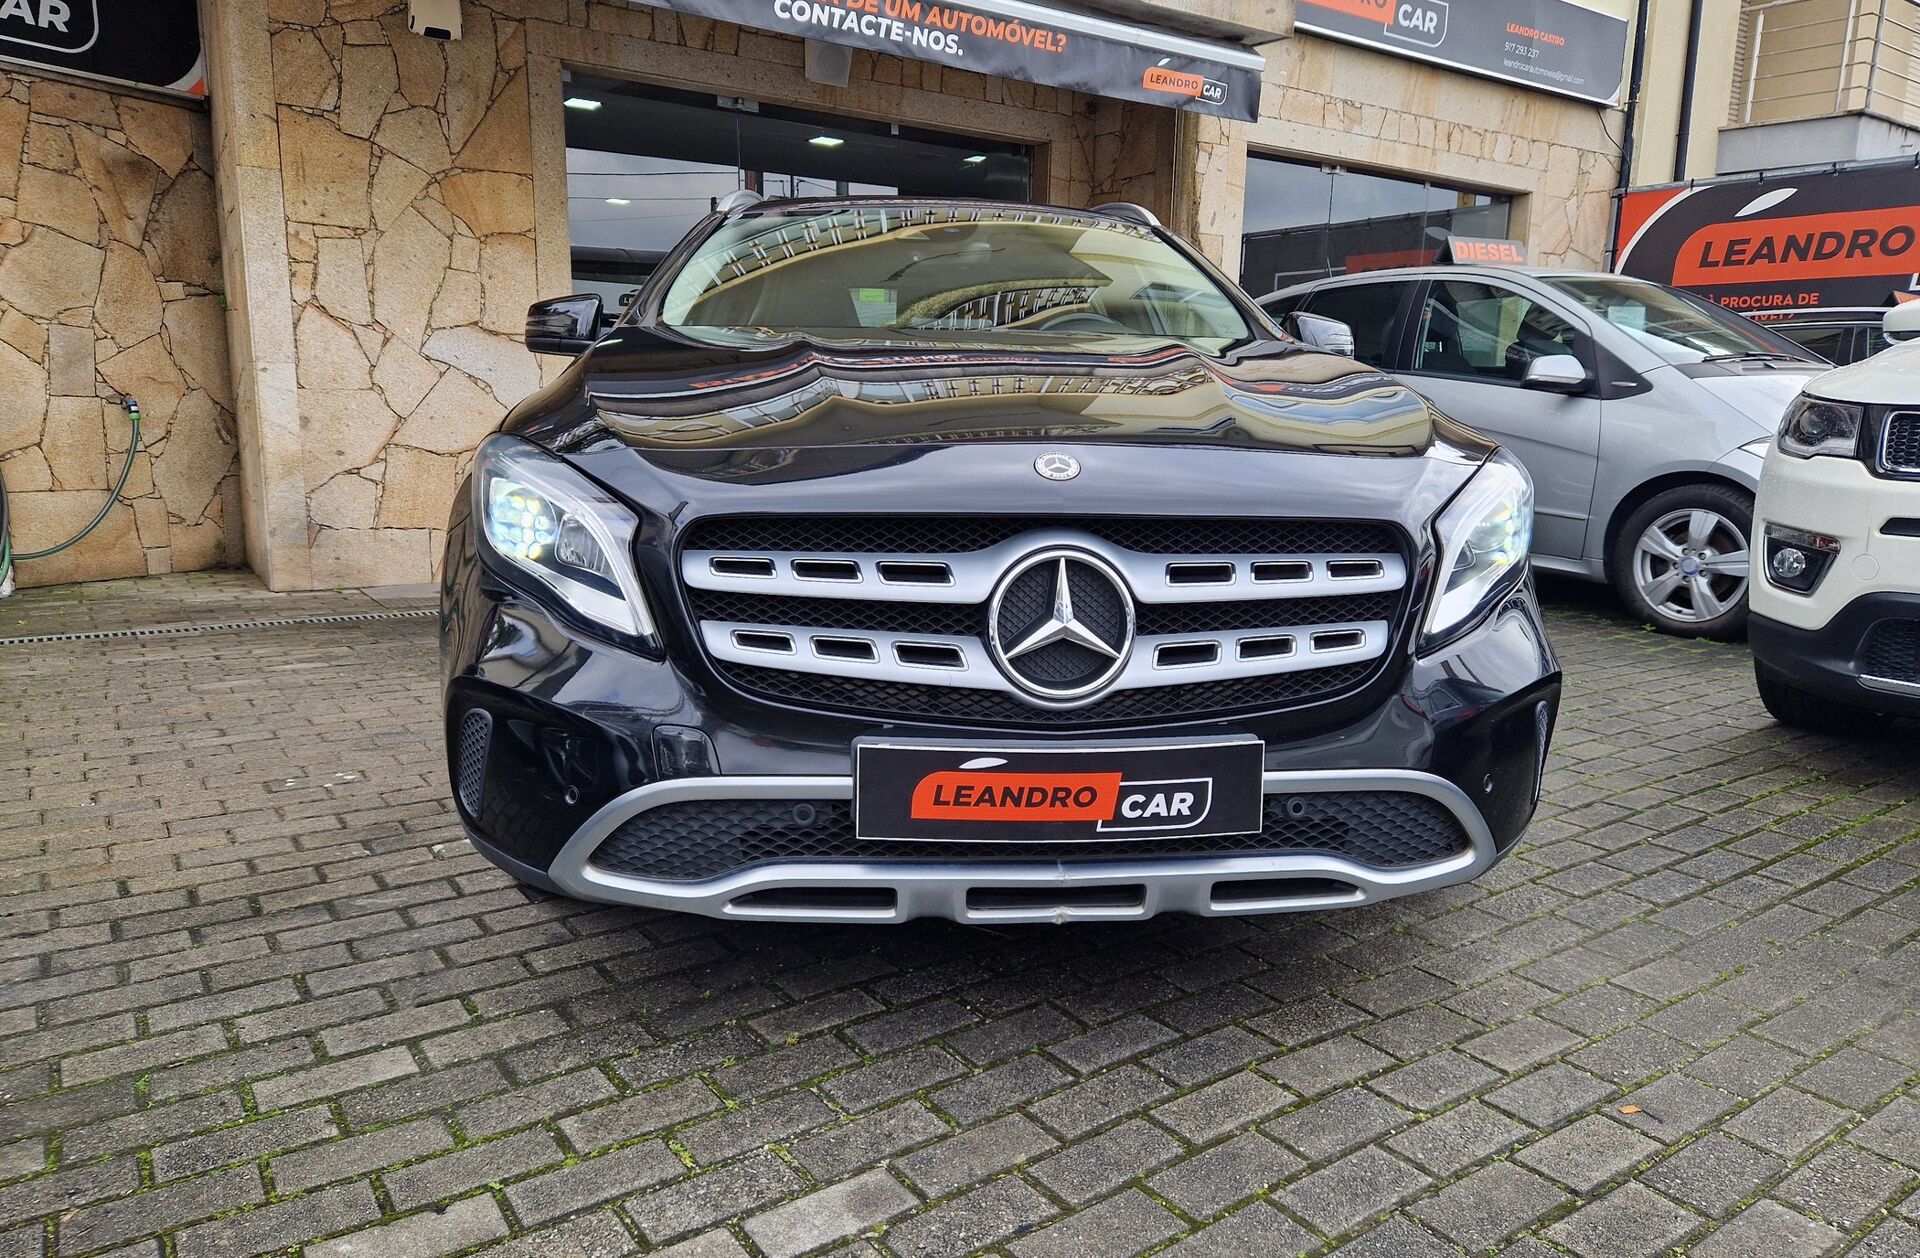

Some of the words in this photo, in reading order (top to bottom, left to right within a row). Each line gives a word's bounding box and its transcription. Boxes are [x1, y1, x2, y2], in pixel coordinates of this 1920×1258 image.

[773, 0, 964, 56] CONTACTE-NOS.
[885, 0, 921, 22] UM
[925, 6, 1067, 53] AUTOMÓVEL?
[1398, 4, 1437, 34] CAR
[1506, 22, 1539, 39] LEANDRO
[1539, 32, 1565, 46] CASTRO
[1504, 42, 1516, 52] 917
[1515, 45, 1527, 56] 293
[1528, 48, 1540, 58] 237
[1149, 73, 1198, 90] LEANDRO
[1203, 84, 1221, 99] CAR
[1455, 241, 1523, 262] DIESEL
[1698, 225, 1916, 268] LEANDRO
[1720, 294, 1794, 308] PROCURA
[1797, 293, 1820, 305] DE
[932, 785, 1098, 808] LEANDRO
[1121, 792, 1194, 818] CAR
